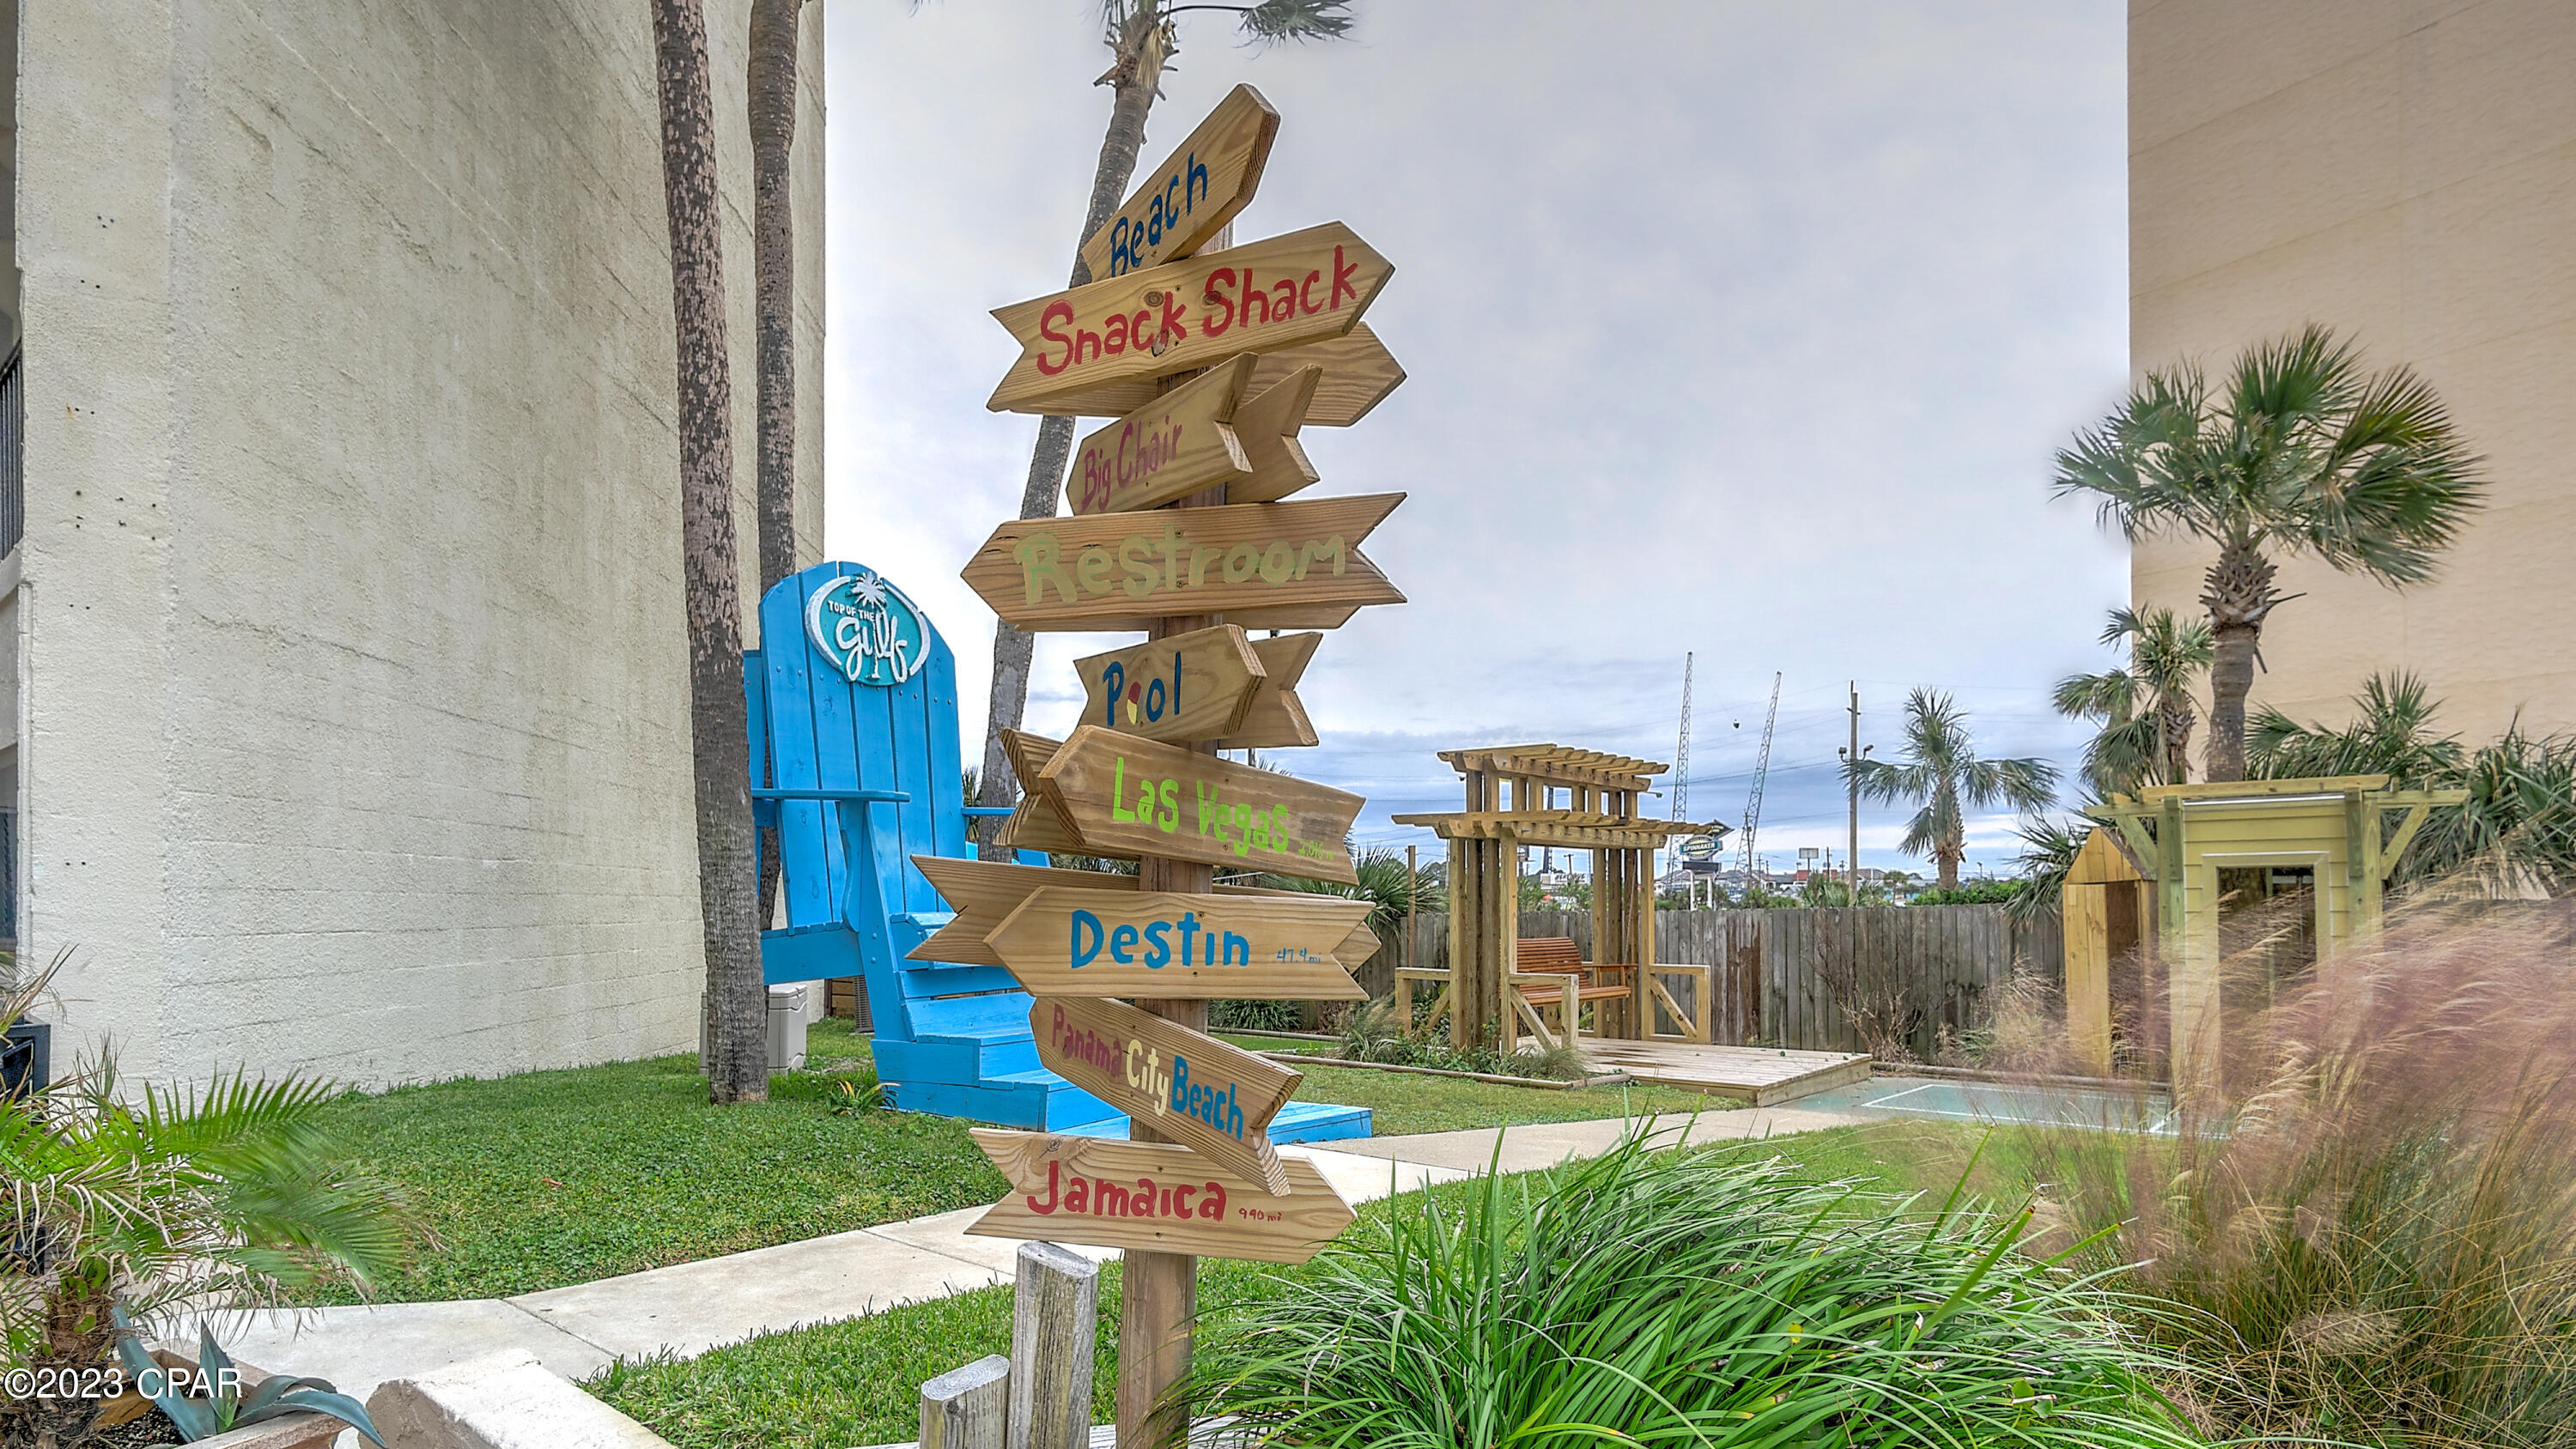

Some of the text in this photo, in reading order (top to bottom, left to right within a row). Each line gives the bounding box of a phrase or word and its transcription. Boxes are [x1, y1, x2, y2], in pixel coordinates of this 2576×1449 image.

[1109, 152, 1209, 276] Beach
[1036, 244, 1359, 376] Snack Shack
[1080, 414, 1183, 512] Big Chair
[1012, 524, 1347, 605] Restroom
[827, 600, 876, 621] TOP OF THE
[1102, 651, 1182, 728] Pool
[1112, 756, 1180, 834] Las
[1196, 779, 1289, 858] Vegas
[1682, 842, 1716, 852] SPINNAKER
[1071, 909, 1250, 969] Destin
[1051, 1003, 1244, 1142] Panama City Beach
[1026, 1160, 1228, 1222] Jamaica
[1238, 1207, 1265, 1221] 990
